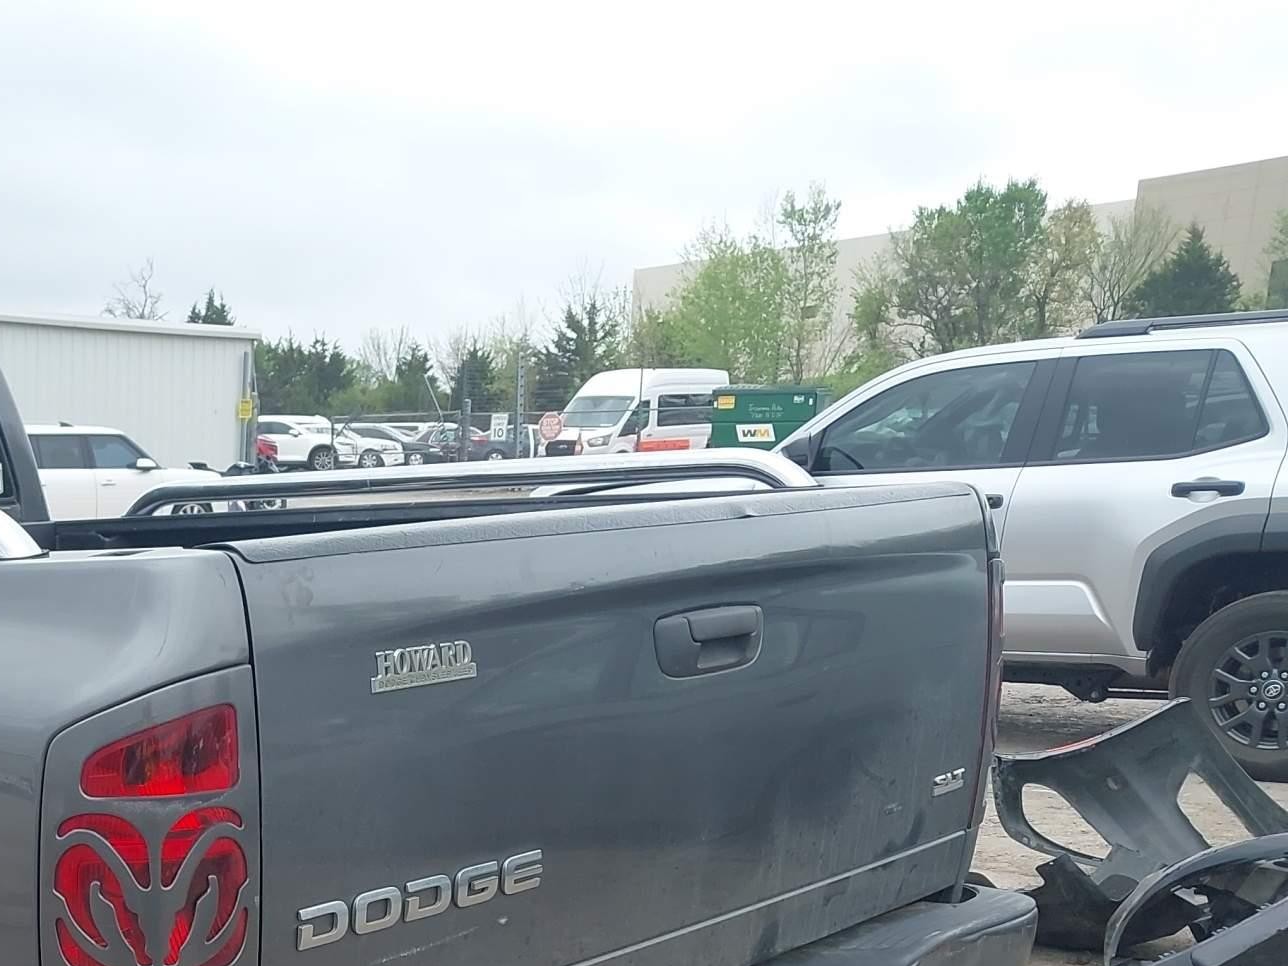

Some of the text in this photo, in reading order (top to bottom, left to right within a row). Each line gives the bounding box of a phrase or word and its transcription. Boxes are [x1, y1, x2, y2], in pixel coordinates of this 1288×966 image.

[493, 427, 504, 438] 10
[741, 428, 770, 438] WM
[375, 640, 472, 679] HOWARD
[934, 768, 966, 787] SLT
[296, 849, 544, 951] DODGE
